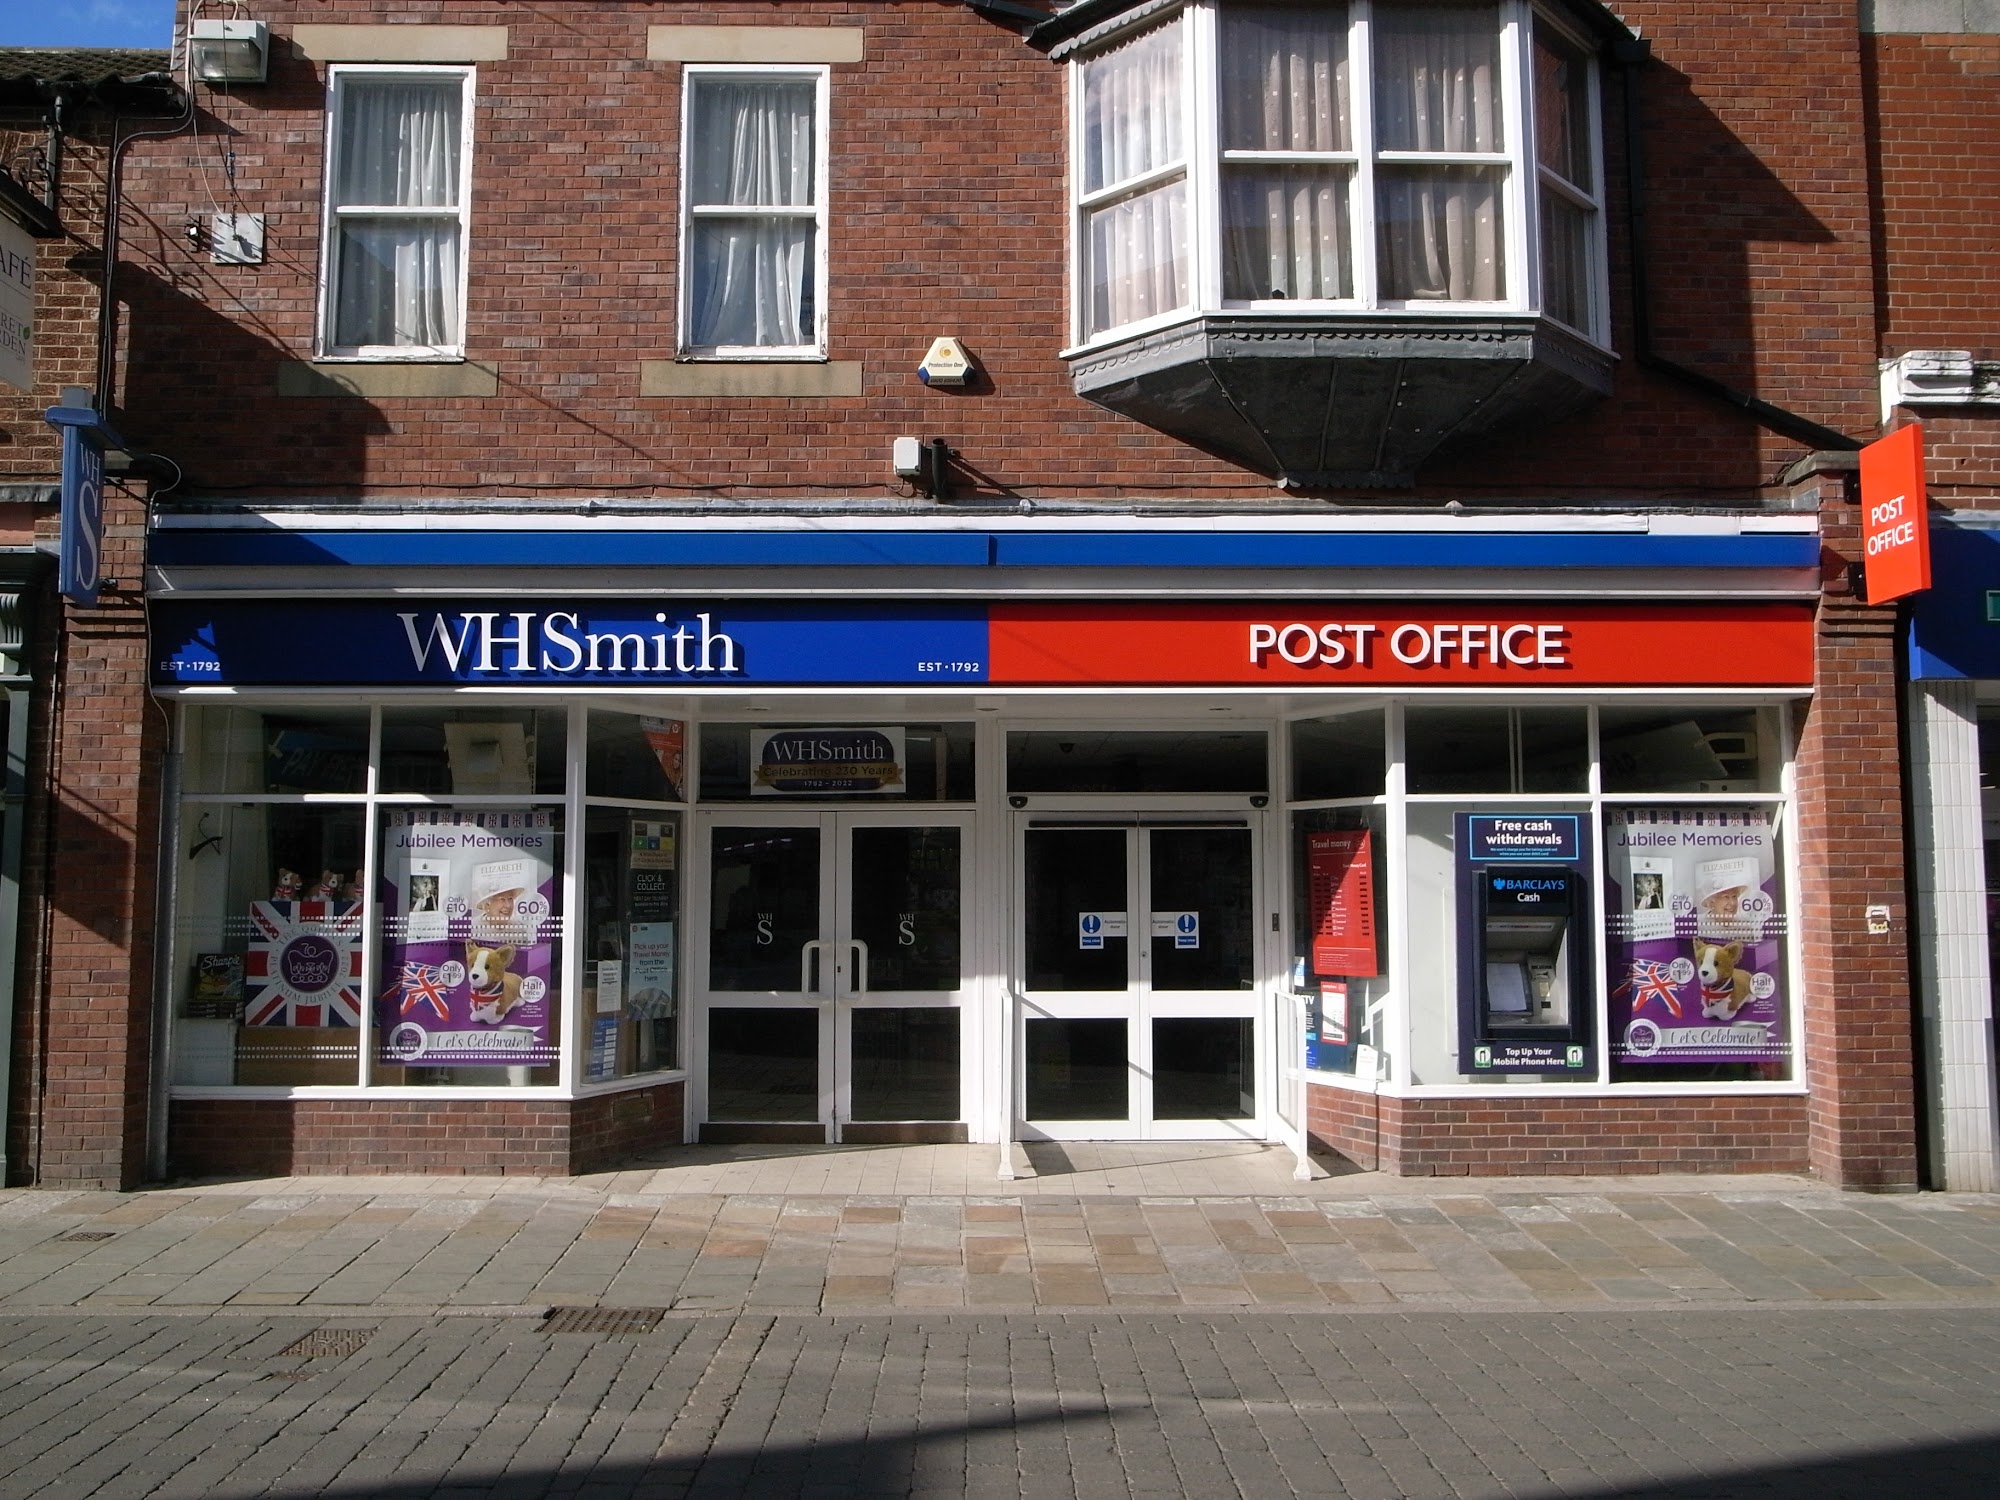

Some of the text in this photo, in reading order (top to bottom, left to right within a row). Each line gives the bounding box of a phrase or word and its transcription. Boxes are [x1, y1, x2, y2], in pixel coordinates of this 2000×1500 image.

[0, 330, 27, 355] DEN
[80, 442, 100, 486] WH
[1871, 495, 1905, 527] POST
[76, 480, 98, 590] S
[1867, 521, 1914, 556] OFFICE
[396, 611, 739, 673] WHSmith
[1250, 623, 1565, 664] POST OFFICE
[771, 739, 885, 761] WHSmith
[763, 766, 893, 778] Celebrating 230 Years
[1494, 819, 1552, 831] Free cash
[396, 833, 543, 848] Jubilee Memories
[1312, 839, 1351, 850] Travel money
[1485, 833, 1562, 845] withdrawals
[1617, 832, 1762, 847] Jubilee Memories
[480, 862, 522, 875] ELIZABETH
[1703, 861, 1744, 872] ELIZABETH
[637, 874, 656, 882] CLICK
[636, 882, 666, 891] COLLECT
[1506, 879, 1565, 890] BARCLAYS
[448, 896, 465, 904] Only
[1517, 892, 1541, 902] Cash
[446, 903, 467, 913] £10
[1671, 901, 1692, 911] £10
[757, 912, 773, 921] WH
[899, 913, 915, 921] WH
[756, 919, 774, 945] S
[898, 920, 916, 946] S
[656, 943, 669, 951] your
[442, 964, 461, 974] Only
[1671, 961, 1691, 971] Only
[522, 981, 543, 991] Half
[1752, 977, 1772, 987] Half
[436, 1033, 527, 1048] Let's Celebrate!
[1671, 1029, 1761, 1044] Let's Celebrate!
[1505, 1048, 1552, 1057] Top Up Your
[1493, 1057, 1520, 1066] Mobile
[1521, 1057, 1546, 1066] Phone
[1546, 1057, 1566, 1066] Here
